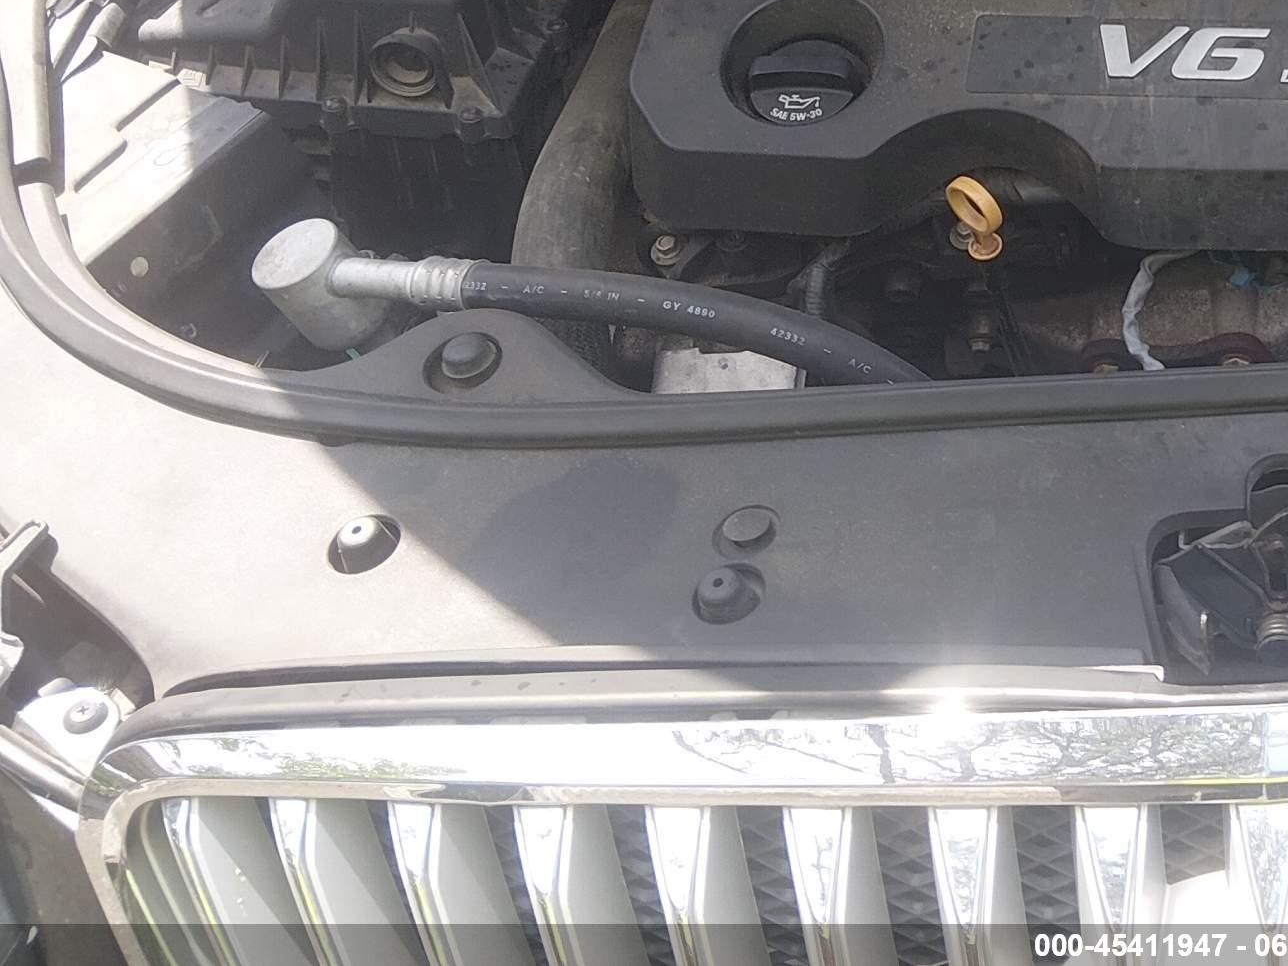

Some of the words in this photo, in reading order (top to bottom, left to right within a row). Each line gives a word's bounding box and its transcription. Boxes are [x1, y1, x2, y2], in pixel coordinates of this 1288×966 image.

[1100, 24, 1271, 81] V6
[770, 108, 788, 121] SAE
[790, 108, 823, 122] 5W-30
[522, 285, 544, 294] A/C
[662, 300, 681, 311] GY
[687, 305, 716, 318] 4890
[770, 328, 806, 346] 42332
[848, 358, 872, 374] A/C
